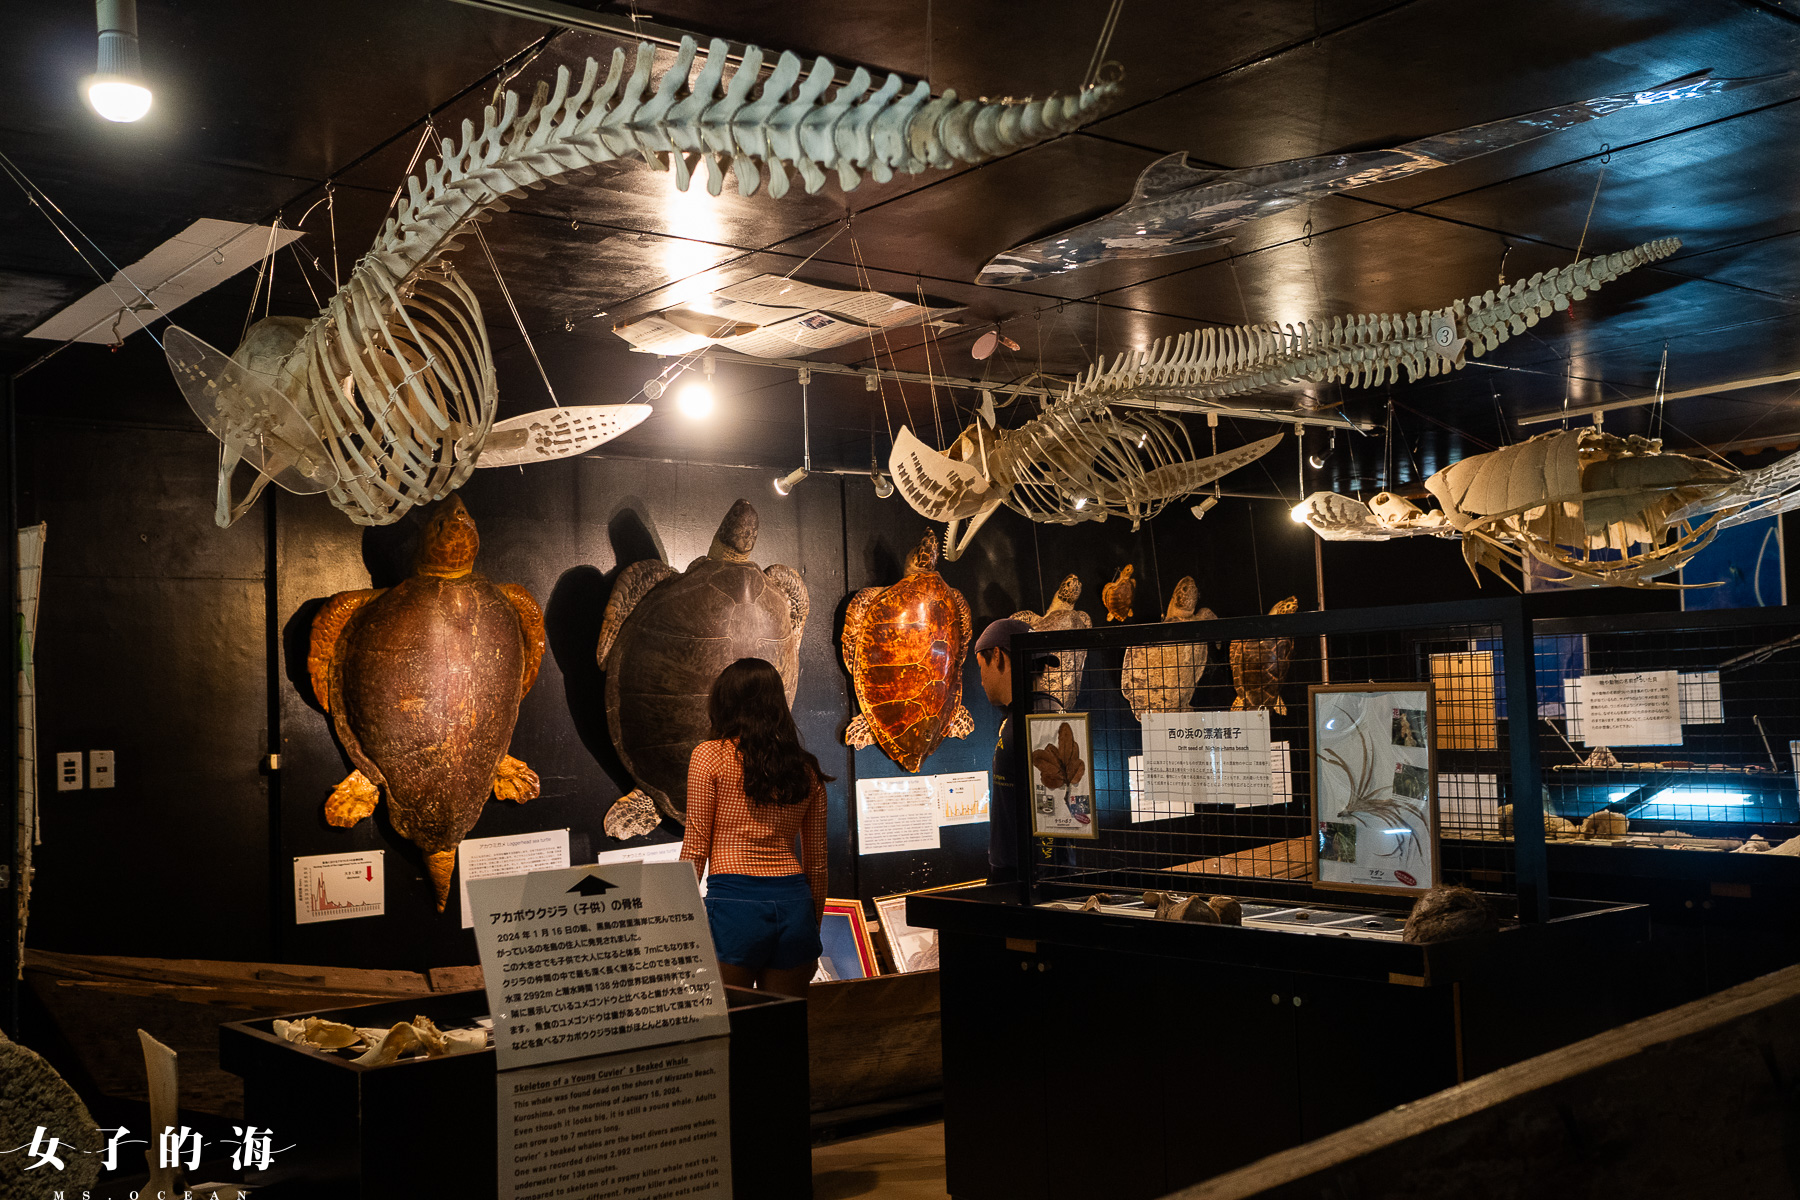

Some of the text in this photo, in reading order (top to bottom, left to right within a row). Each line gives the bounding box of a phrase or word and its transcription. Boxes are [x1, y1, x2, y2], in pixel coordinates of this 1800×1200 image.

[1168, 727, 1242, 740] 西の浜の漂着種子
[506, 838, 532, 847] Loggerhead
[496, 933, 642, 958] がっているのを島の住人に発見されました。
[497, 932, 520, 942] 2024
[552, 927, 563, 936] 16
[595, 982, 610, 991] 138
[513, 1081, 550, 1092] Skeleton
[571, 1073, 595, 1083] Young
[635, 1061, 663, 1071] Beaked
[665, 1057, 688, 1066] Whale
[513, 1100, 529, 1108] This
[530, 1096, 552, 1105] whale
[570, 1089, 590, 1098] found
[592, 1086, 609, 1094] dead
[634, 1079, 653, 1087] shore
[664, 1072, 693, 1082] Miyazato
[513, 1126, 533, 1135] Even
[535, 1122, 562, 1131] though
[572, 1116, 592, 1125] looks
[626, 1106, 640, 1115] still
[648, 1102, 669, 1111] young
[695, 1093, 716, 1103] Adults
[568, 1104, 580, 1112] the
[582, 1101, 610, 1109] morning
[621, 1094, 648, 1102] January
[514, 1141, 527, 1149] can
[529, 1138, 547, 1146] grow
[577, 1128, 601, 1137] meters
[550, 1146, 575, 1155] beaked
[577, 1141, 602, 1150] whales
[630, 1132, 646, 1140] best
[647, 1128, 668, 1136] divers
[669, 1124, 691, 1133] among
[514, 1167, 529, 1176] One
[549, 1159, 582, 1169] recorded
[584, 1153, 607, 1162] diving
[633, 1144, 657, 1152] meters
[659, 1139, 676, 1147] deep
[678, 1135, 691, 1144] and
[692, 1131, 717, 1141] staying
[514, 1178, 557, 1189] underwater
[572, 1170, 586, 1178] 138
[566, 1182, 598, 1192] skeleton
[617, 1173, 640, 1182] pygmy
[642, 1168, 660, 1177] killer
[662, 1163, 683, 1173] whale
[684, 1160, 700, 1169] next
[623, 1184, 645, 1194] Pygmy
[647, 1180, 666, 1188] killer
[667, 1175, 687, 1184] whale
[689, 1172, 704, 1180] eats
[705, 1168, 719, 1177] fish
[675, 1188, 690, 1196] eats
[692, 1182, 710, 1192] squid
